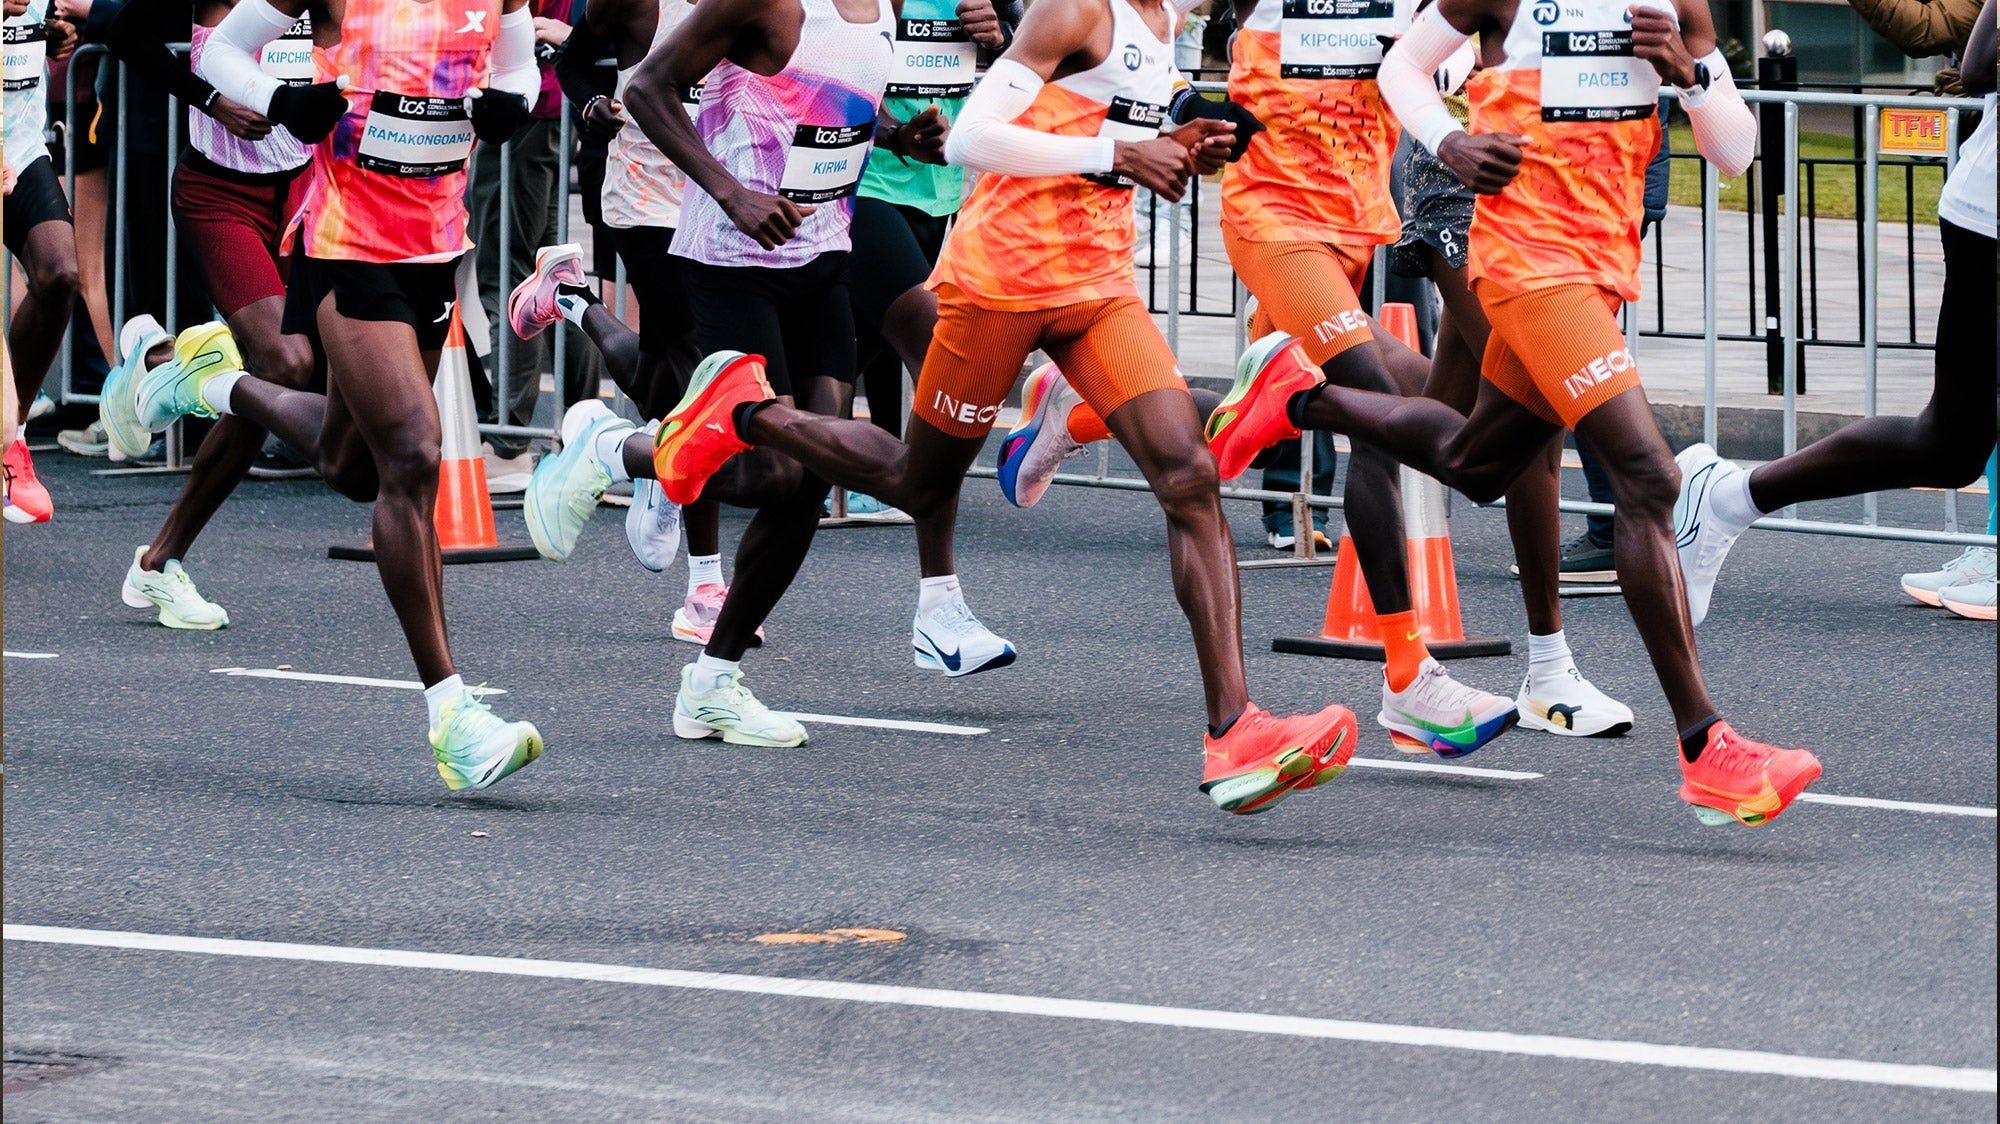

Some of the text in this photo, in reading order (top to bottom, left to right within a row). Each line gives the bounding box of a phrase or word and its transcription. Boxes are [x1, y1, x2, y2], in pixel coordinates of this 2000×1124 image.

[1307, 0, 1334, 14] tcs
[1566, 9, 1584, 18] NN
[285, 22, 303, 35] cs
[907, 20, 930, 37] tcs
[1300, 33, 1377, 47] KIPCHOGE
[1568, 32, 1597, 52] tcs
[905, 54, 960, 68] GOBENA
[1578, 72, 1629, 87] PACE3
[689, 86, 703, 99] tc
[398, 96, 426, 115] tcs
[1128, 101, 1147, 122] tcs
[1888, 114, 1936, 137] TFH
[367, 125, 472, 145] RAMAKONGOANA
[815, 127, 839, 144] tcs
[812, 159, 848, 174] KIRWA
